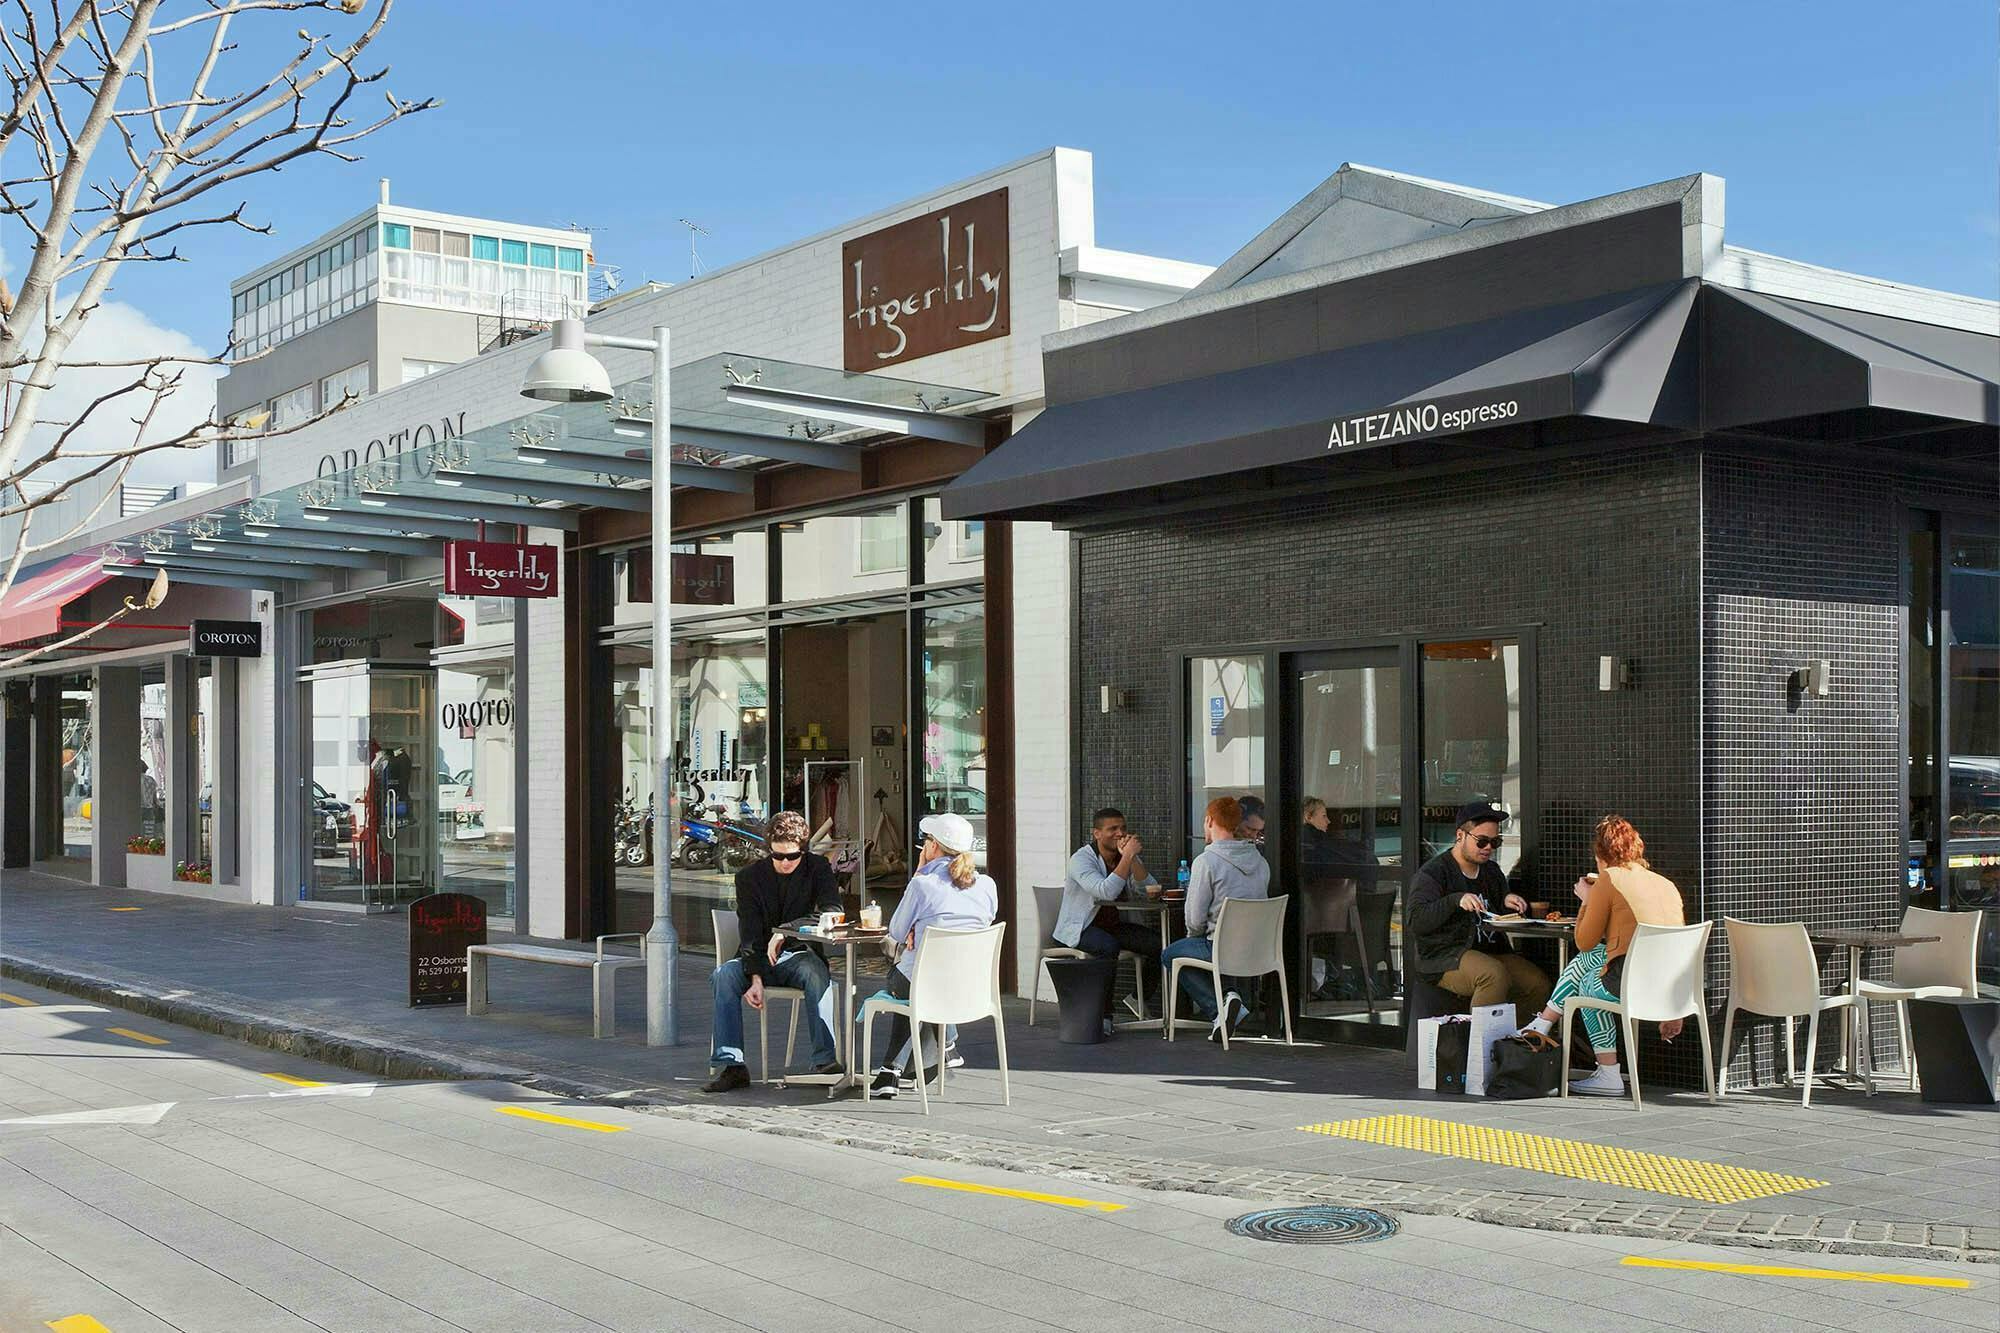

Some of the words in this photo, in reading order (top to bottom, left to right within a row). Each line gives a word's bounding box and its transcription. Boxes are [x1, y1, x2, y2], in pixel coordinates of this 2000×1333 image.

[849, 215, 1002, 359] tigerlily
[1327, 404, 1439, 450] ALTEZANO
[1441, 400, 1518, 430] espresso
[318, 411, 466, 500] OROTON
[465, 549, 550, 592] tigerlily
[200, 632, 257, 645] OROTON
[442, 698, 515, 730] OROTO
[418, 957, 430, 967] 22
[418, 968, 428, 976] Ph
[429, 967, 443, 976] 529
[443, 966, 462, 975] 0172
